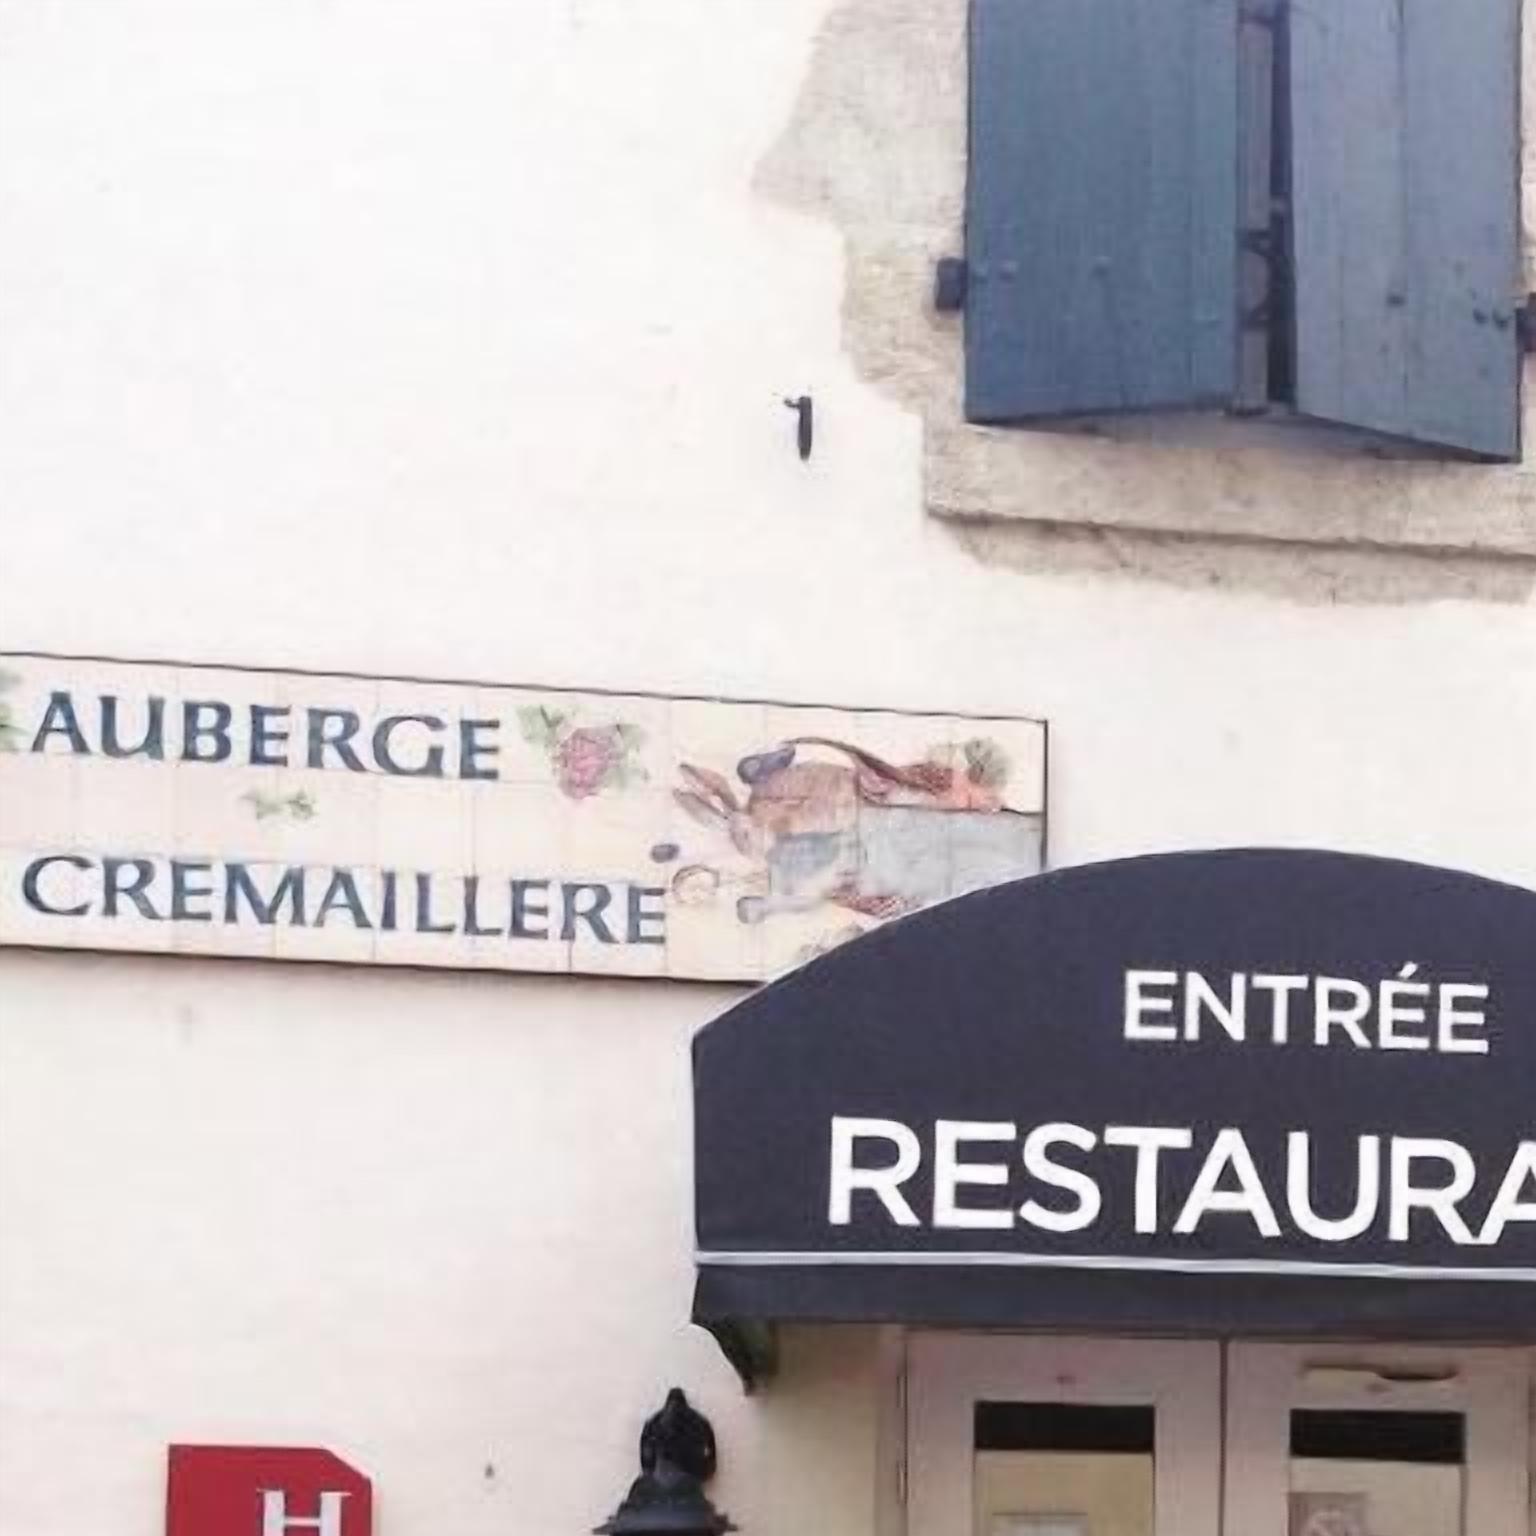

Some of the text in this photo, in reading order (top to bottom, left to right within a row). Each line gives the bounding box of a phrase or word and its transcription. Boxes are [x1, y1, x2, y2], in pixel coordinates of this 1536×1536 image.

[30, 688, 502, 781] AUBERGE
[20, 852, 668, 947] CREMAILLERE
[1123, 961, 1490, 1055] ENTRÉE
